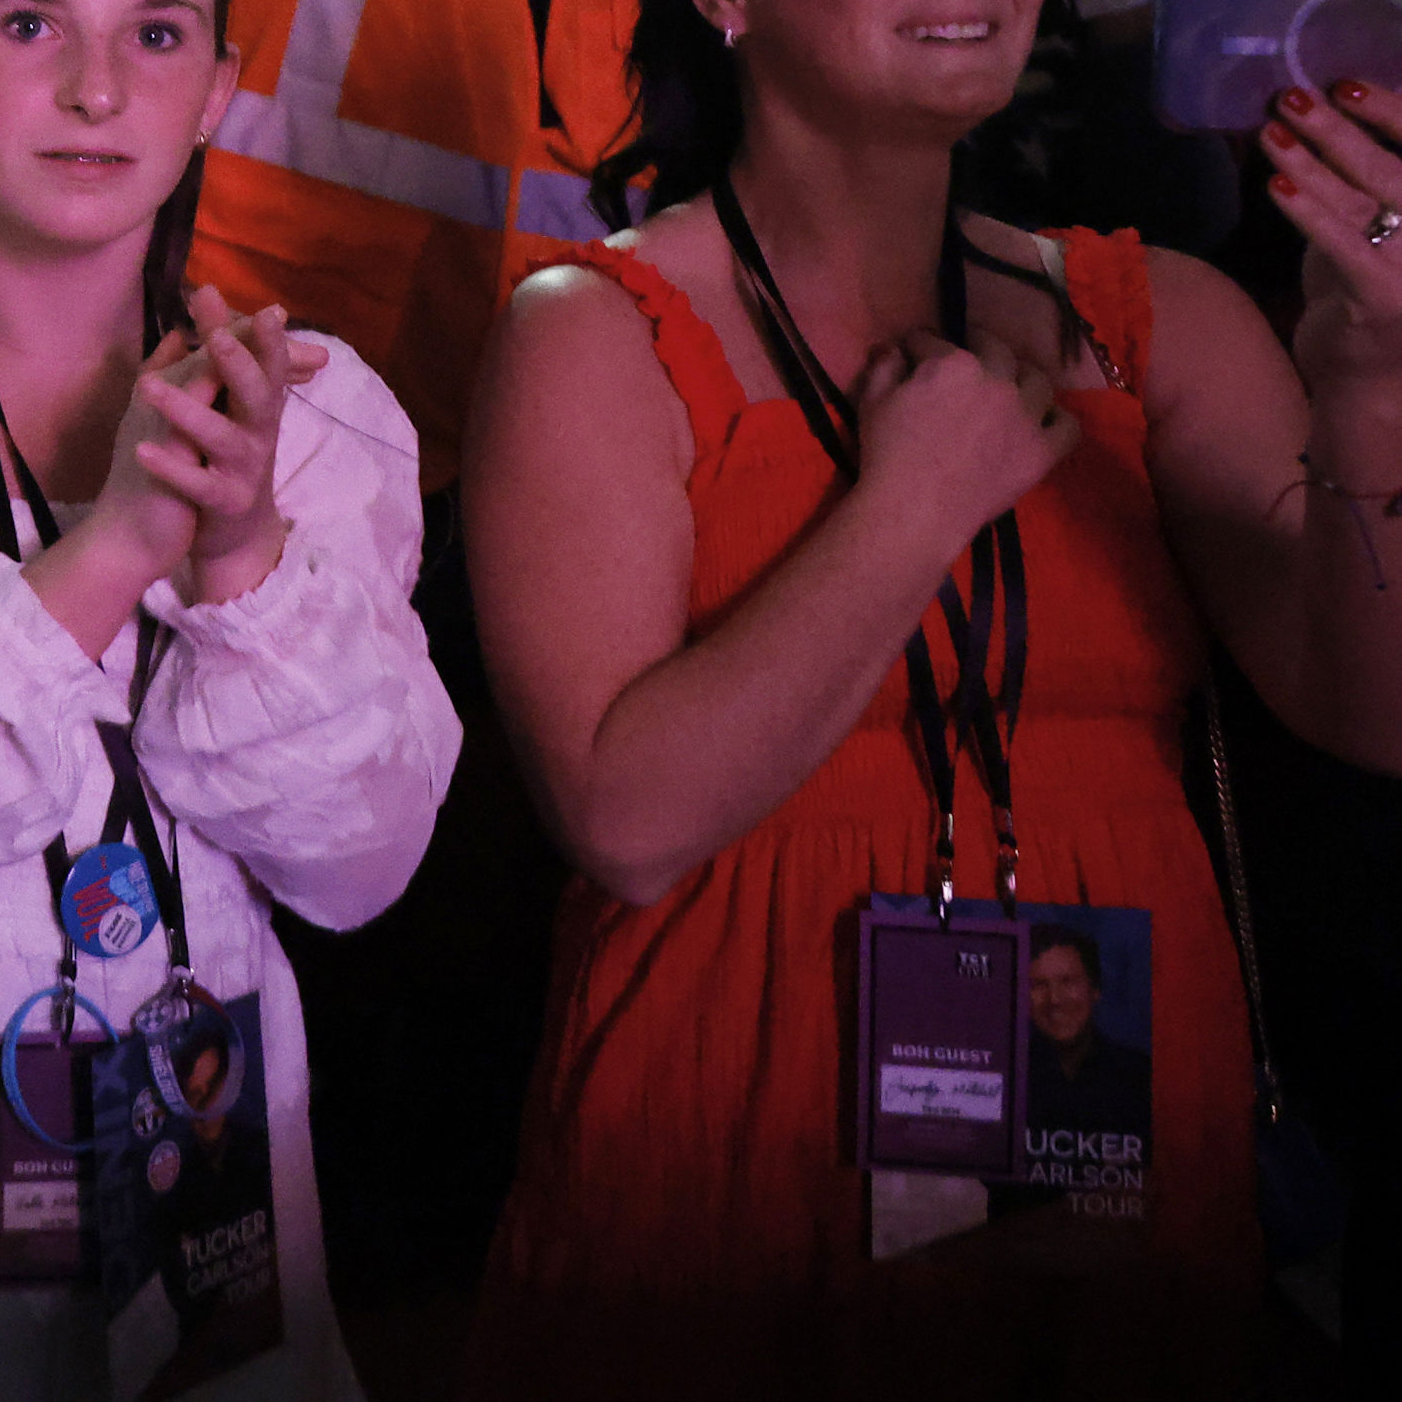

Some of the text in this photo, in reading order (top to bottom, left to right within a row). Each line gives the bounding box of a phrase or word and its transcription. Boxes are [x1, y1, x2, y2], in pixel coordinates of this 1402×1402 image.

[1025, 1127, 1143, 1163] UCKER
[1030, 1161, 1143, 1190] ARLSON
[1067, 1190, 1145, 1221] TOUR
[179, 1209, 267, 1268] TUCKER
